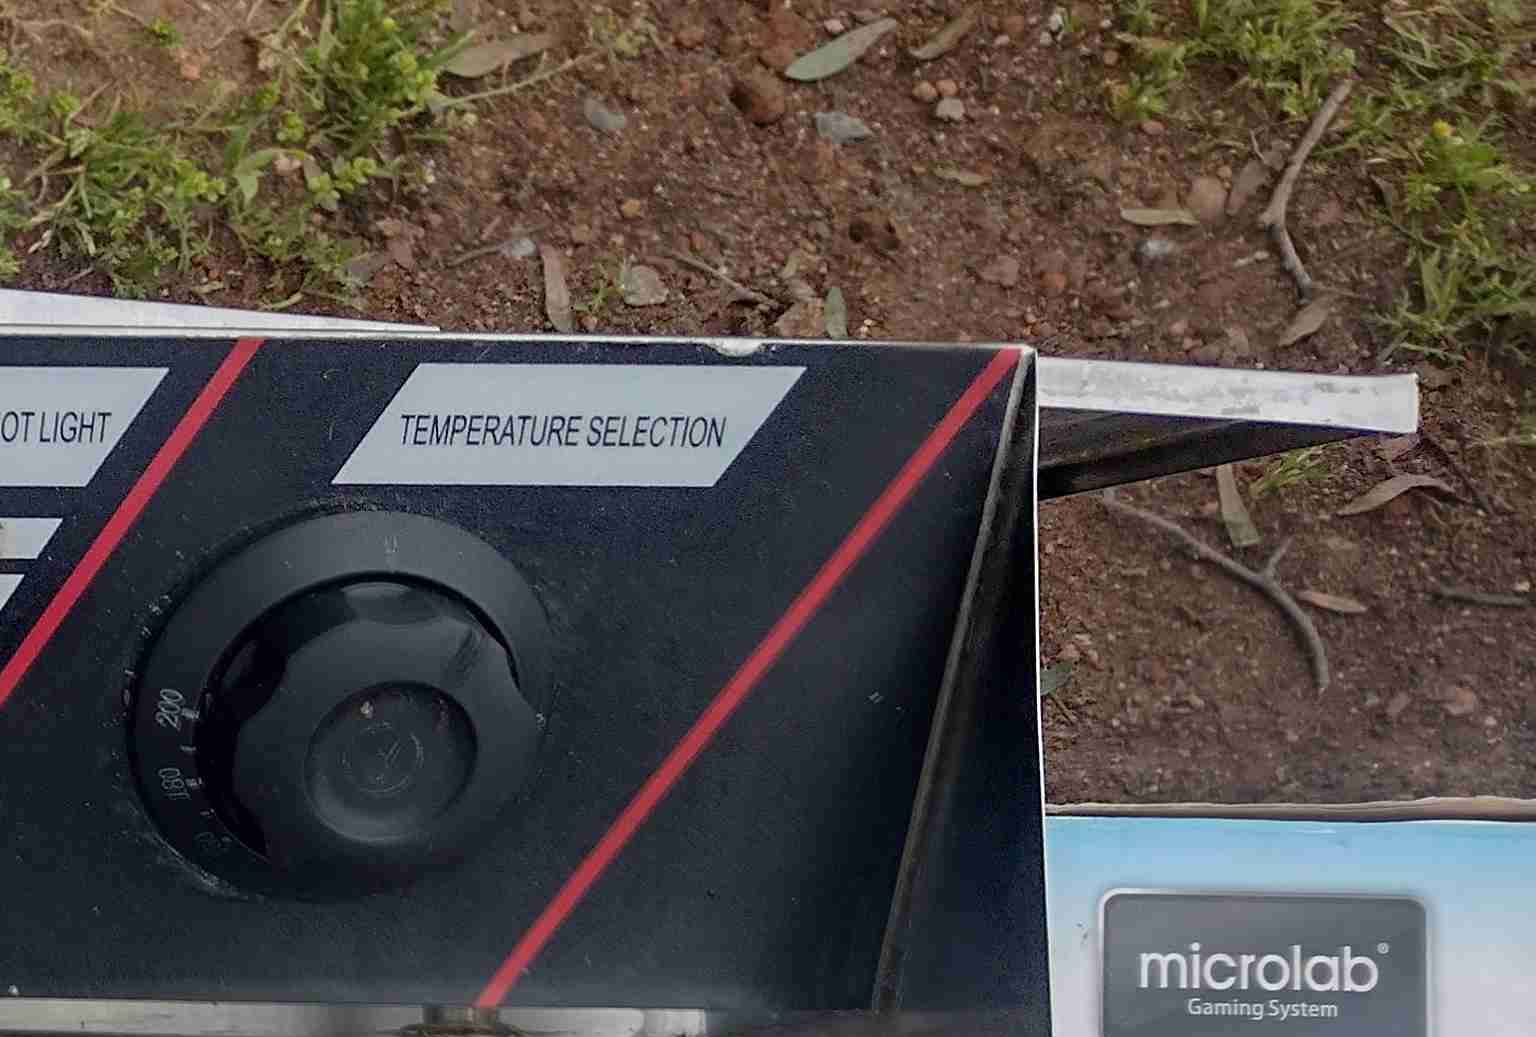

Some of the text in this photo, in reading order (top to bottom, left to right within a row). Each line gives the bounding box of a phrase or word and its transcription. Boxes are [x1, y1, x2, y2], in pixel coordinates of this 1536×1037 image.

[39, 411, 112, 443] LIGHT
[399, 414, 726, 449] TEMPERATURE SELECTION
[1187, 998, 1338, 1020] Gaming System
